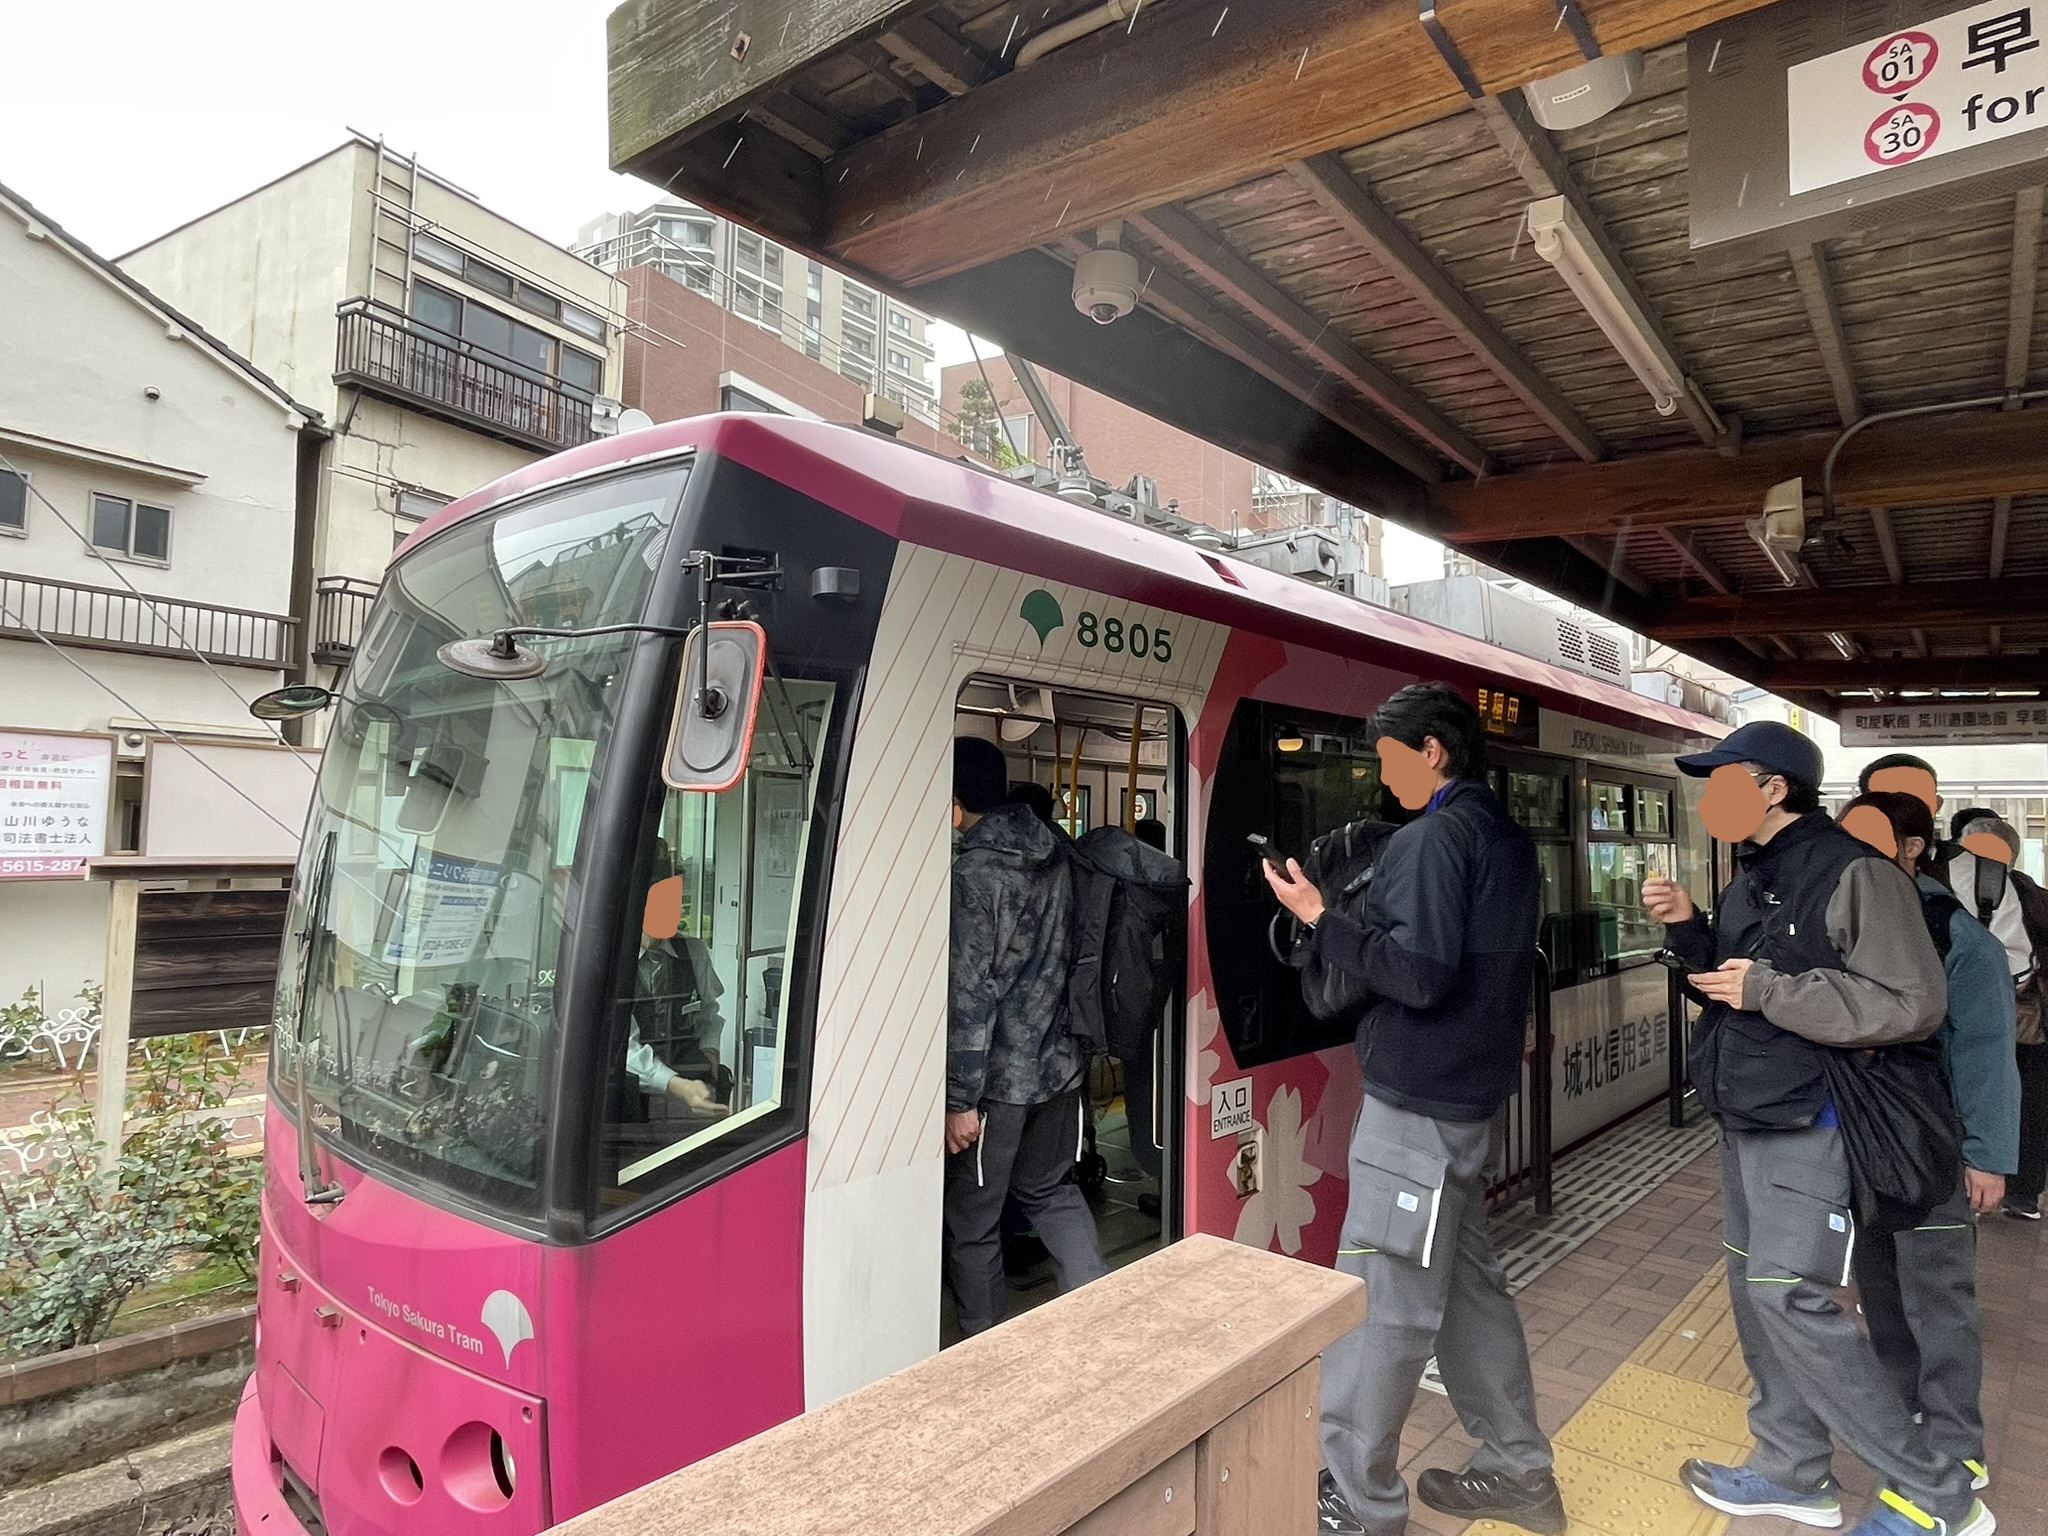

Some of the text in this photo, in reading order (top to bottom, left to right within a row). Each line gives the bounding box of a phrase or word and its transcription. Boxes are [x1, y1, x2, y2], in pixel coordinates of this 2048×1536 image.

[1889, 43, 1912, 59] SA
[1961, 7, 2040, 74] 早
[1881, 55, 1914, 82] 01
[1891, 114, 1914, 130] SA
[1961, 86, 2045, 131] for
[1883, 127, 1921, 154] 30
[1077, 611, 1171, 662] 8805
[3, 832, 92, 844] 司法書士法人
[0, 859, 84, 872] 5615-287
[1563, 1012, 1668, 1101] 城北信用金庫
[1218, 1087, 1246, 1114] 入口
[1213, 1110, 1250, 1132] ENTRANCE
[367, 1285, 483, 1354] Tokyo Sakura Tram
